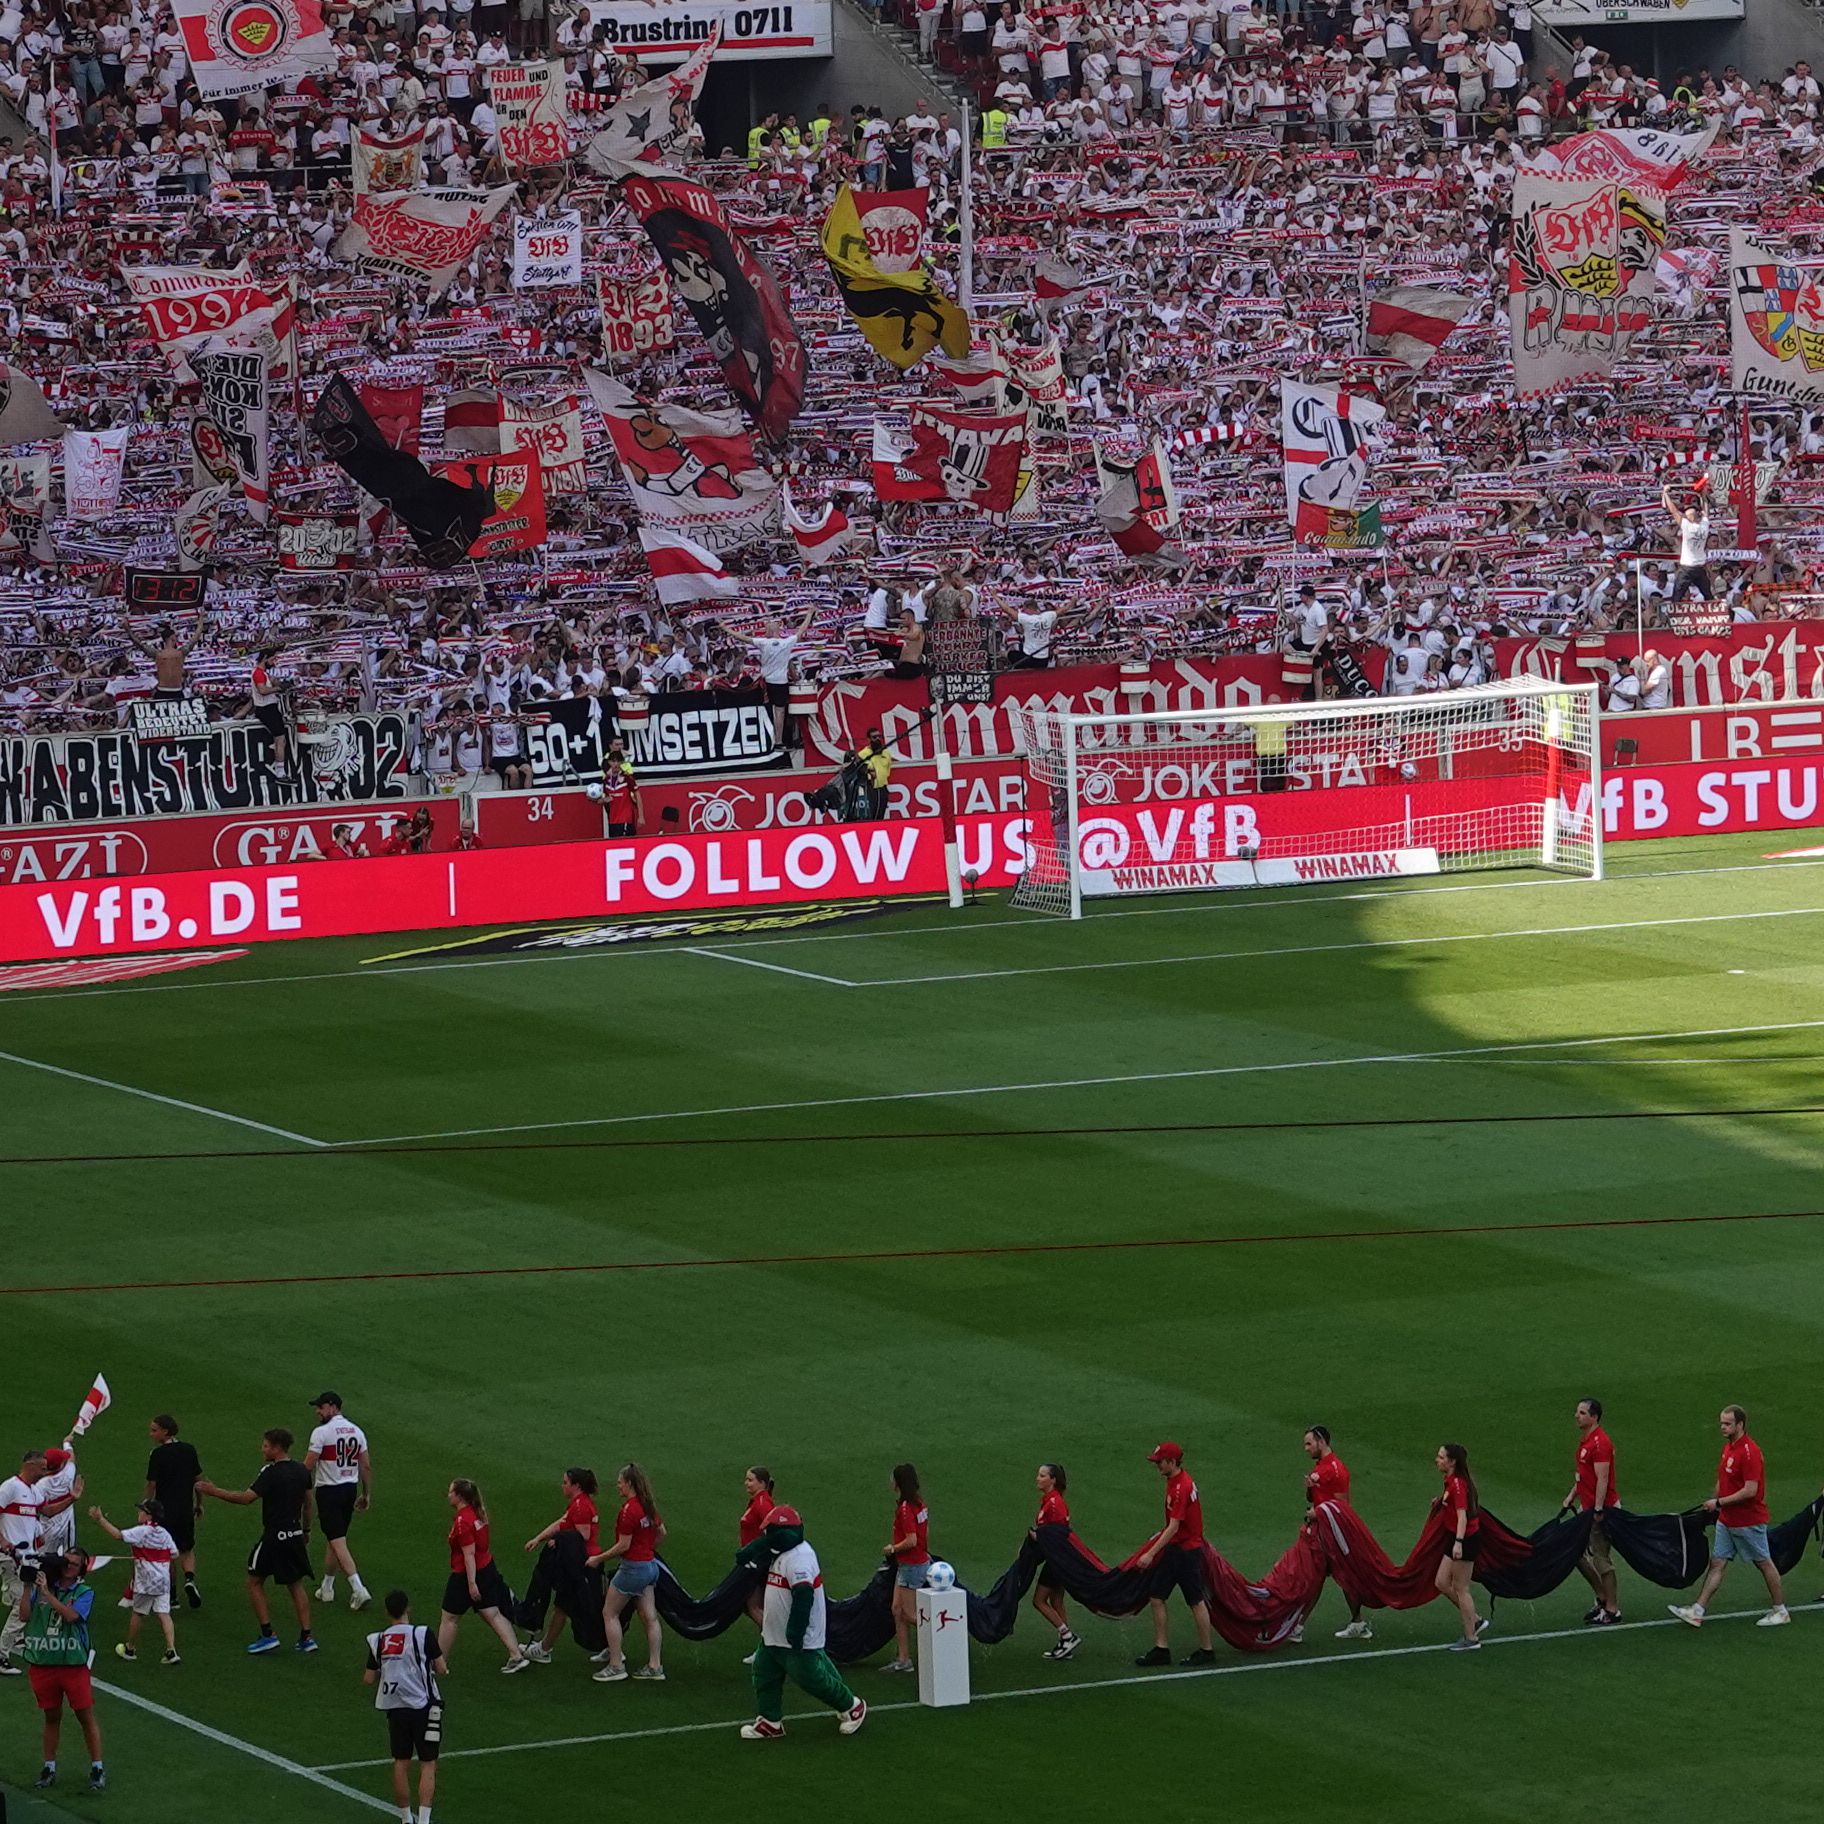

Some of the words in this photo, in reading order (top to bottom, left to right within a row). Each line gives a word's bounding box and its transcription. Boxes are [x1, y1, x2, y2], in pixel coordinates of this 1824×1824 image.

[734, 6, 794, 34] 0711
[491, 68, 526, 84] FEUER
[529, 69, 549, 83] UND
[494, 84, 543, 102] FLAMME
[508, 109, 528, 122] DEN
[146, 287, 259, 342] 1997
[605, 314, 674, 359] 1893
[1304, 529, 1376, 547] Commando
[1504, 609, 1569, 620] COMMANDO
[1667, 603, 1706, 614] ULTRA
[1707, 602, 1728, 614] IST
[1067, 645, 1130, 655] COMMANDO
[946, 674, 962, 684] DU
[132, 698, 206, 719] ULTRAS
[135, 712, 209, 729] BEDEUTET
[806, 658, 1264, 765] Commando
[137, 723, 213, 741] WIDERSTAND
[526, 720, 602, 775] 50+1
[613, 702, 776, 764] UMSETZEN
[526, 795, 555, 822] 34
[605, 825, 921, 903] FOLLOW
[954, 816, 1036, 877] US
[1078, 801, 1261, 870] @VfB
[1111, 862, 1219, 891] WINAMAX
[1293, 851, 1401, 881] WINAMAX
[36, 875, 304, 948] VfB.DE
[335, 1436, 359, 1469] 92
